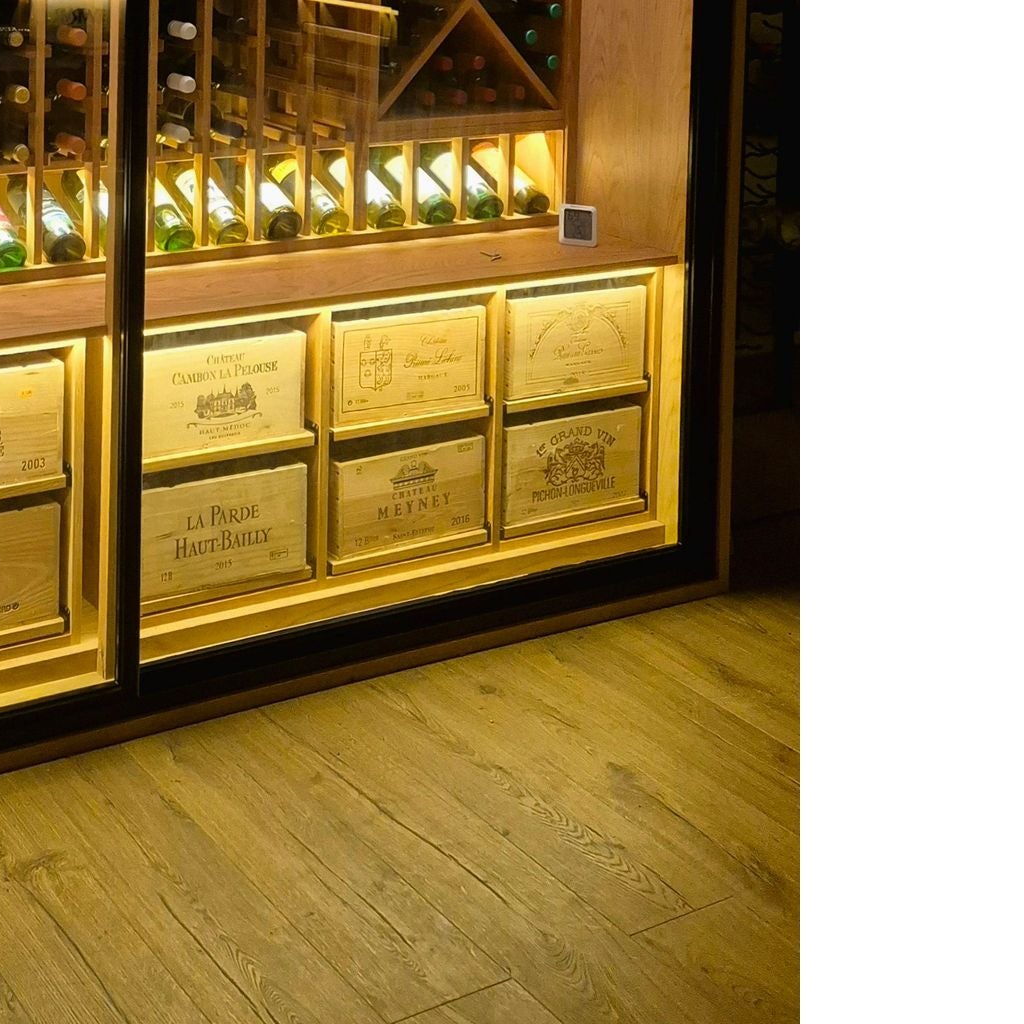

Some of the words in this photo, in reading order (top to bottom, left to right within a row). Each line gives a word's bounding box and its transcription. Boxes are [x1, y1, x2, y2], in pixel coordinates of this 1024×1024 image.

[172, 370, 216, 386] CAMBON
[219, 368, 232, 380] LA
[234, 360, 279, 378] PELOUSE
[453, 384, 471, 394] 2005
[550, 426, 592, 446] GRAND
[597, 428, 616, 448] VIN
[21, 457, 46, 472] 2003
[532, 476, 616, 504] PICHON-LONGUEVILLE
[187, 515, 204, 531] LA
[210, 504, 261, 527] PARDE
[378, 492, 451, 520] MEYNEY
[451, 514, 470, 526] 2016
[174, 527, 273, 561] HAUT-BAILLY
